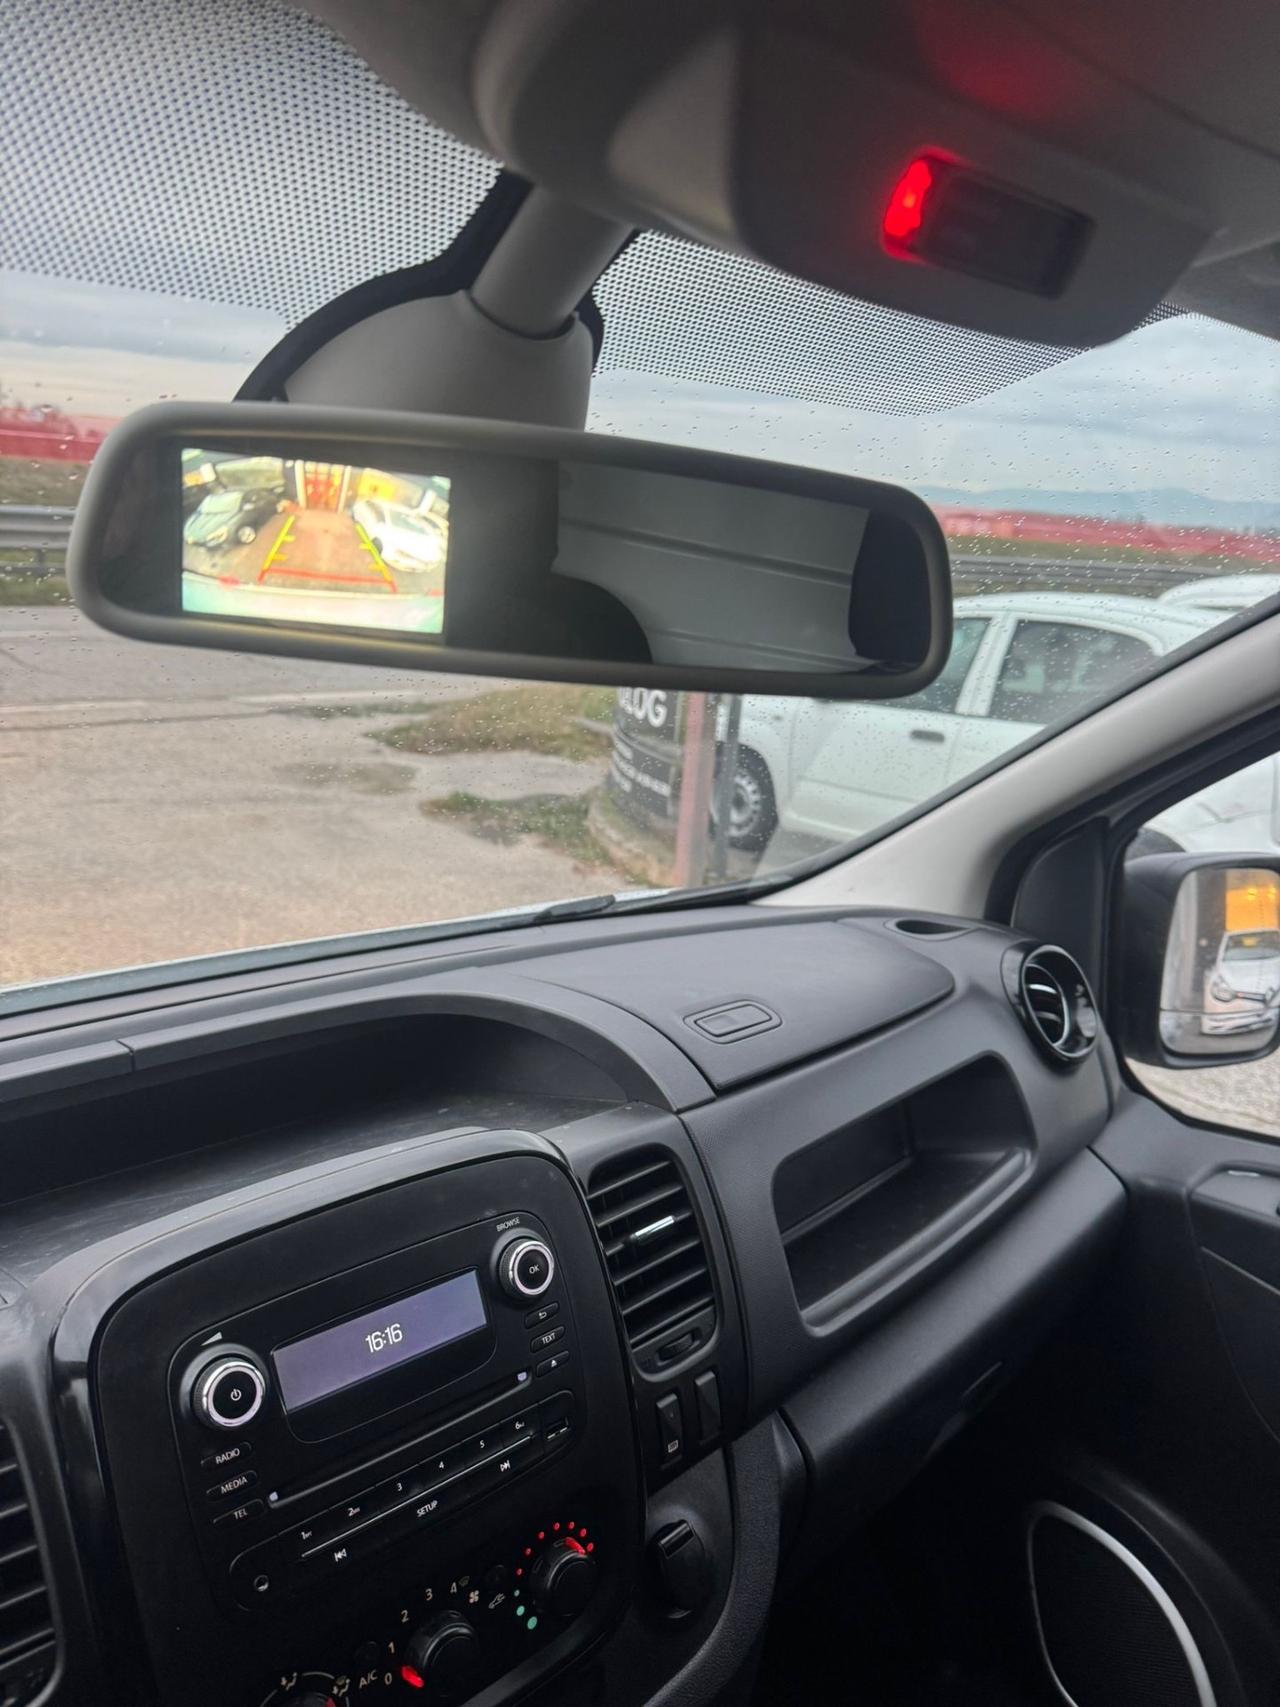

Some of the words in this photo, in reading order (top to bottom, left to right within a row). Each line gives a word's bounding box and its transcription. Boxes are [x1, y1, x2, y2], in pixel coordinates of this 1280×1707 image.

[496, 1216, 521, 1232] BROWSE
[529, 1264, 540, 1275] OK
[365, 1323, 403, 1353] 16:16
[541, 1332, 556, 1346] TEXT
[479, 1440, 485, 1449] 5
[215, 1448, 241, 1465] RADIO
[438, 1461, 445, 1470] 4
[220, 1476, 249, 1495] MEDIA
[396, 1482, 403, 1492] 3
[233, 1508, 248, 1520] TEL
[416, 1500, 439, 1518] SETUP
[425, 1588, 433, 1601] 3
[449, 1582, 458, 1594] 4
[401, 1609, 410, 1623] 2
[387, 1641, 395, 1654] 1
[359, 1669, 378, 1689] A/C
[384, 1672, 393, 1685] 0
